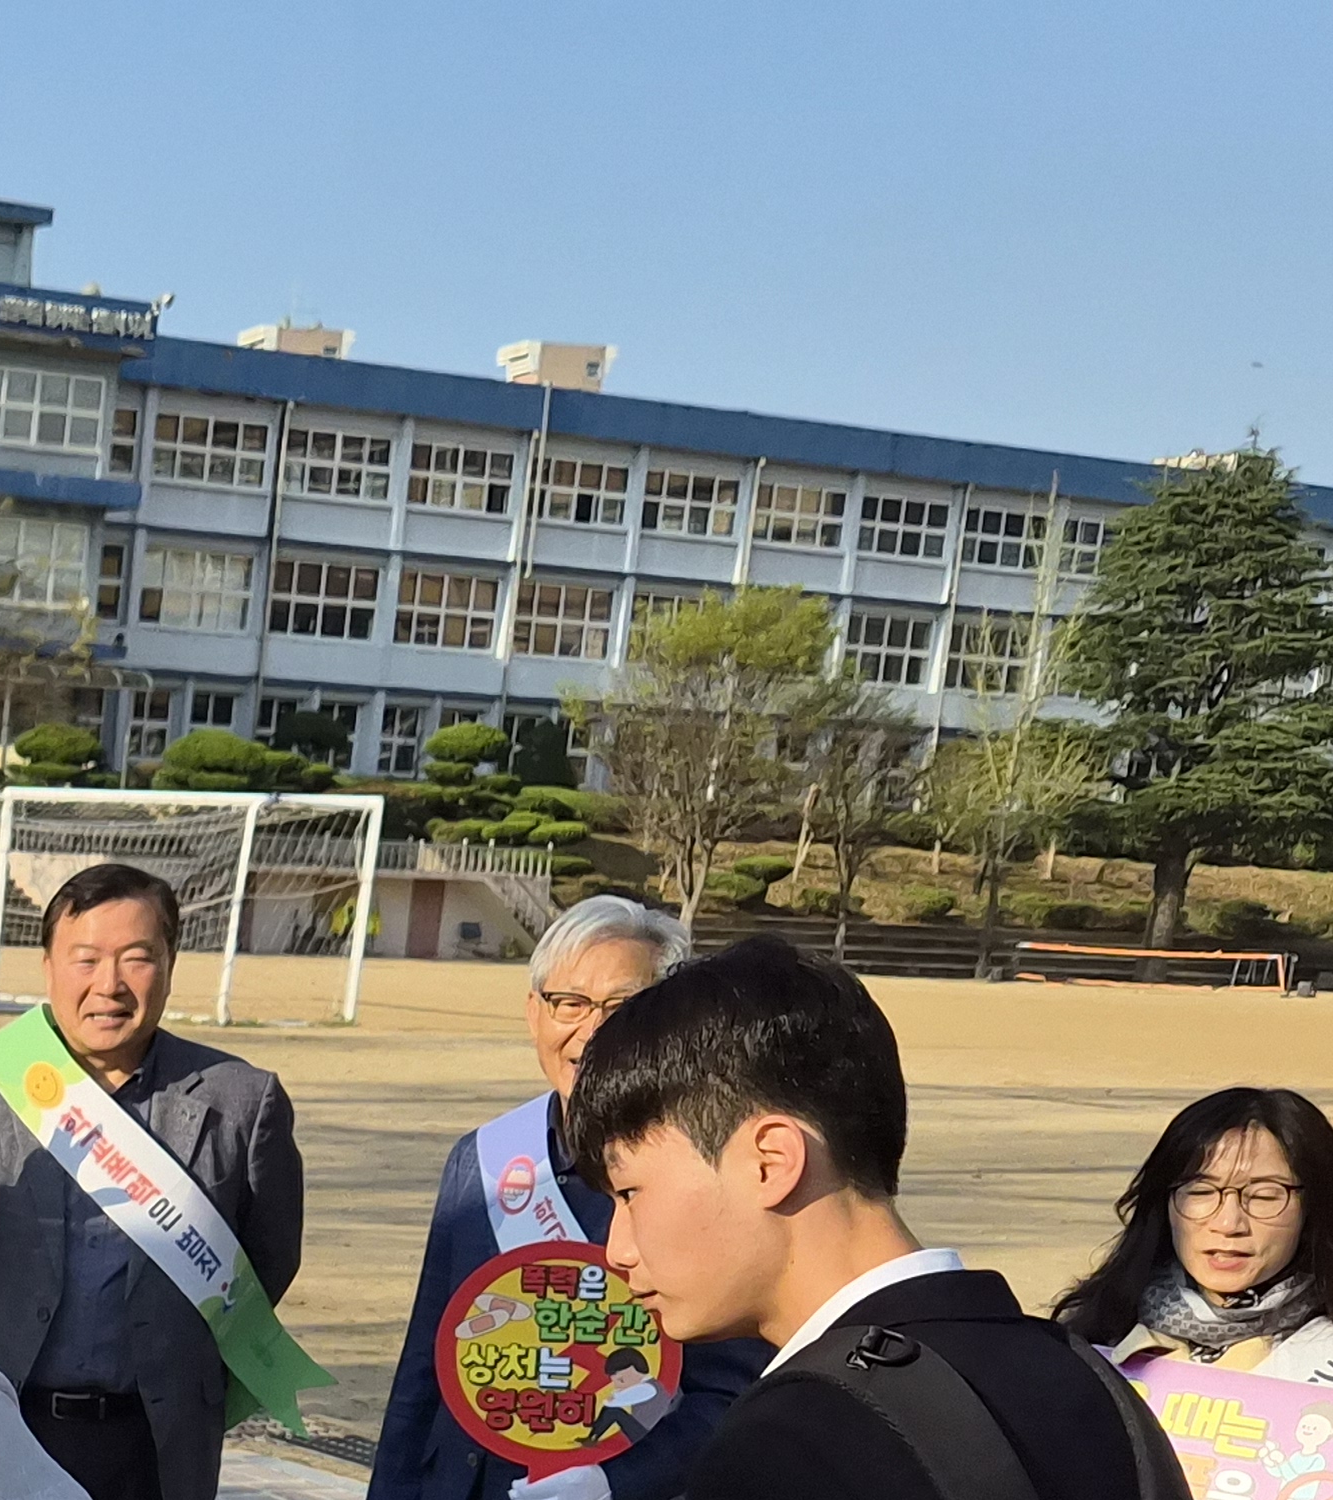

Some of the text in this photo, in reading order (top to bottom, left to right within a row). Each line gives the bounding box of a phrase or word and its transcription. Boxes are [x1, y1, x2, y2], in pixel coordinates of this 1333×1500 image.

[520, 1263, 607, 1300] 폭력은
[534, 1298, 660, 1346] 한순간,
[460, 1343, 572, 1389] 상처는
[476, 1385, 596, 1433] 영원히
